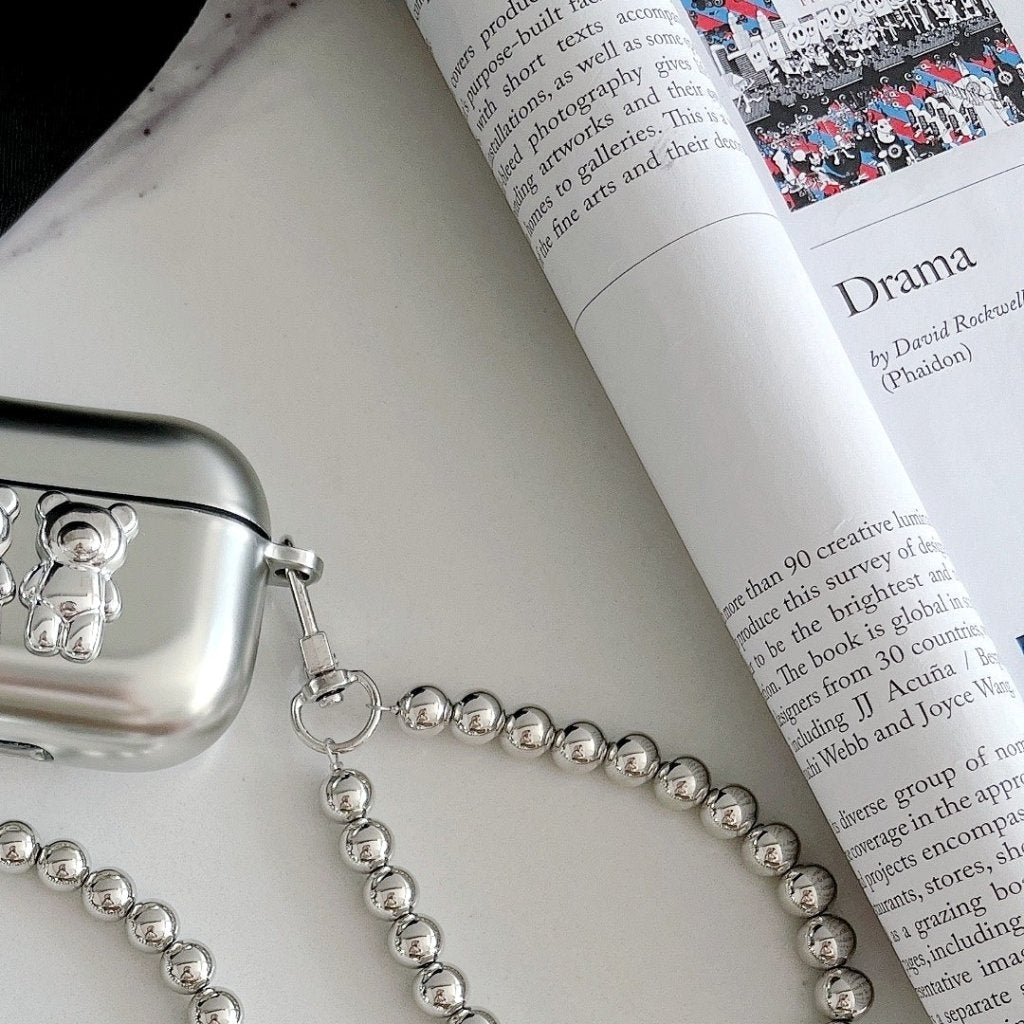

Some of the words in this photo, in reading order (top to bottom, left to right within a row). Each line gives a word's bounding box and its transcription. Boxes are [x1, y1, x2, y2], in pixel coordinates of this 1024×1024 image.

[450, 45, 476, 89] covers
[479, 0, 539, 50] produ
[465, 7, 564, 111] purpose-built
[476, 98, 498, 132] with
[501, 53, 546, 98] short
[555, 20, 604, 52] texts
[553, 69, 575, 91] as
[575, 39, 621, 74] well
[622, 37, 643, 53] as
[527, 66, 643, 155] photography
[654, 55, 692, 79] gives
[538, 113, 615, 176] artworks
[622, 85, 661, 116] and
[666, 80, 704, 100] their
[552, 216, 581, 240] fine
[582, 179, 618, 212] arts
[621, 149, 662, 184] and
[666, 134, 710, 161] their
[555, 178, 573, 197] to
[576, 124, 664, 186] galleries.
[661, 107, 704, 129] This
[831, 246, 977, 318] Drama
[869, 349, 889, 370] by
[892, 320, 951, 358] David
[880, 342, 973, 394] (Phaidon)
[745, 570, 785, 600] than
[783, 549, 812, 577] 90
[816, 520, 894, 560] creative
[782, 584, 821, 613] this
[825, 551, 892, 591] survey
[897, 537, 917, 560] of
[764, 640, 787, 659] be
[790, 618, 824, 644] the
[827, 573, 925, 623] brightest
[928, 561, 953, 584] and
[776, 662, 810, 686] The
[807, 630, 864, 669] book
[866, 622, 886, 642] is
[891, 593, 950, 637] global
[822, 675, 873, 700] from
[875, 644, 906, 672] 30
[850, 690, 874, 723] JJ
[887, 664, 958, 704] Acuña
[817, 733, 870, 768] Webb
[873, 708, 916, 743] and
[916, 690, 976, 728] Joyce
[838, 798, 888, 830] diverse
[894, 767, 956, 809] group
[966, 745, 990, 772] of
[910, 812, 936, 832] in
[934, 796, 973, 820] the
[864, 852, 919, 893] projects
[924, 860, 994, 896] stores,
[914, 895, 988, 941] grazing
[926, 915, 1024, 962] including
